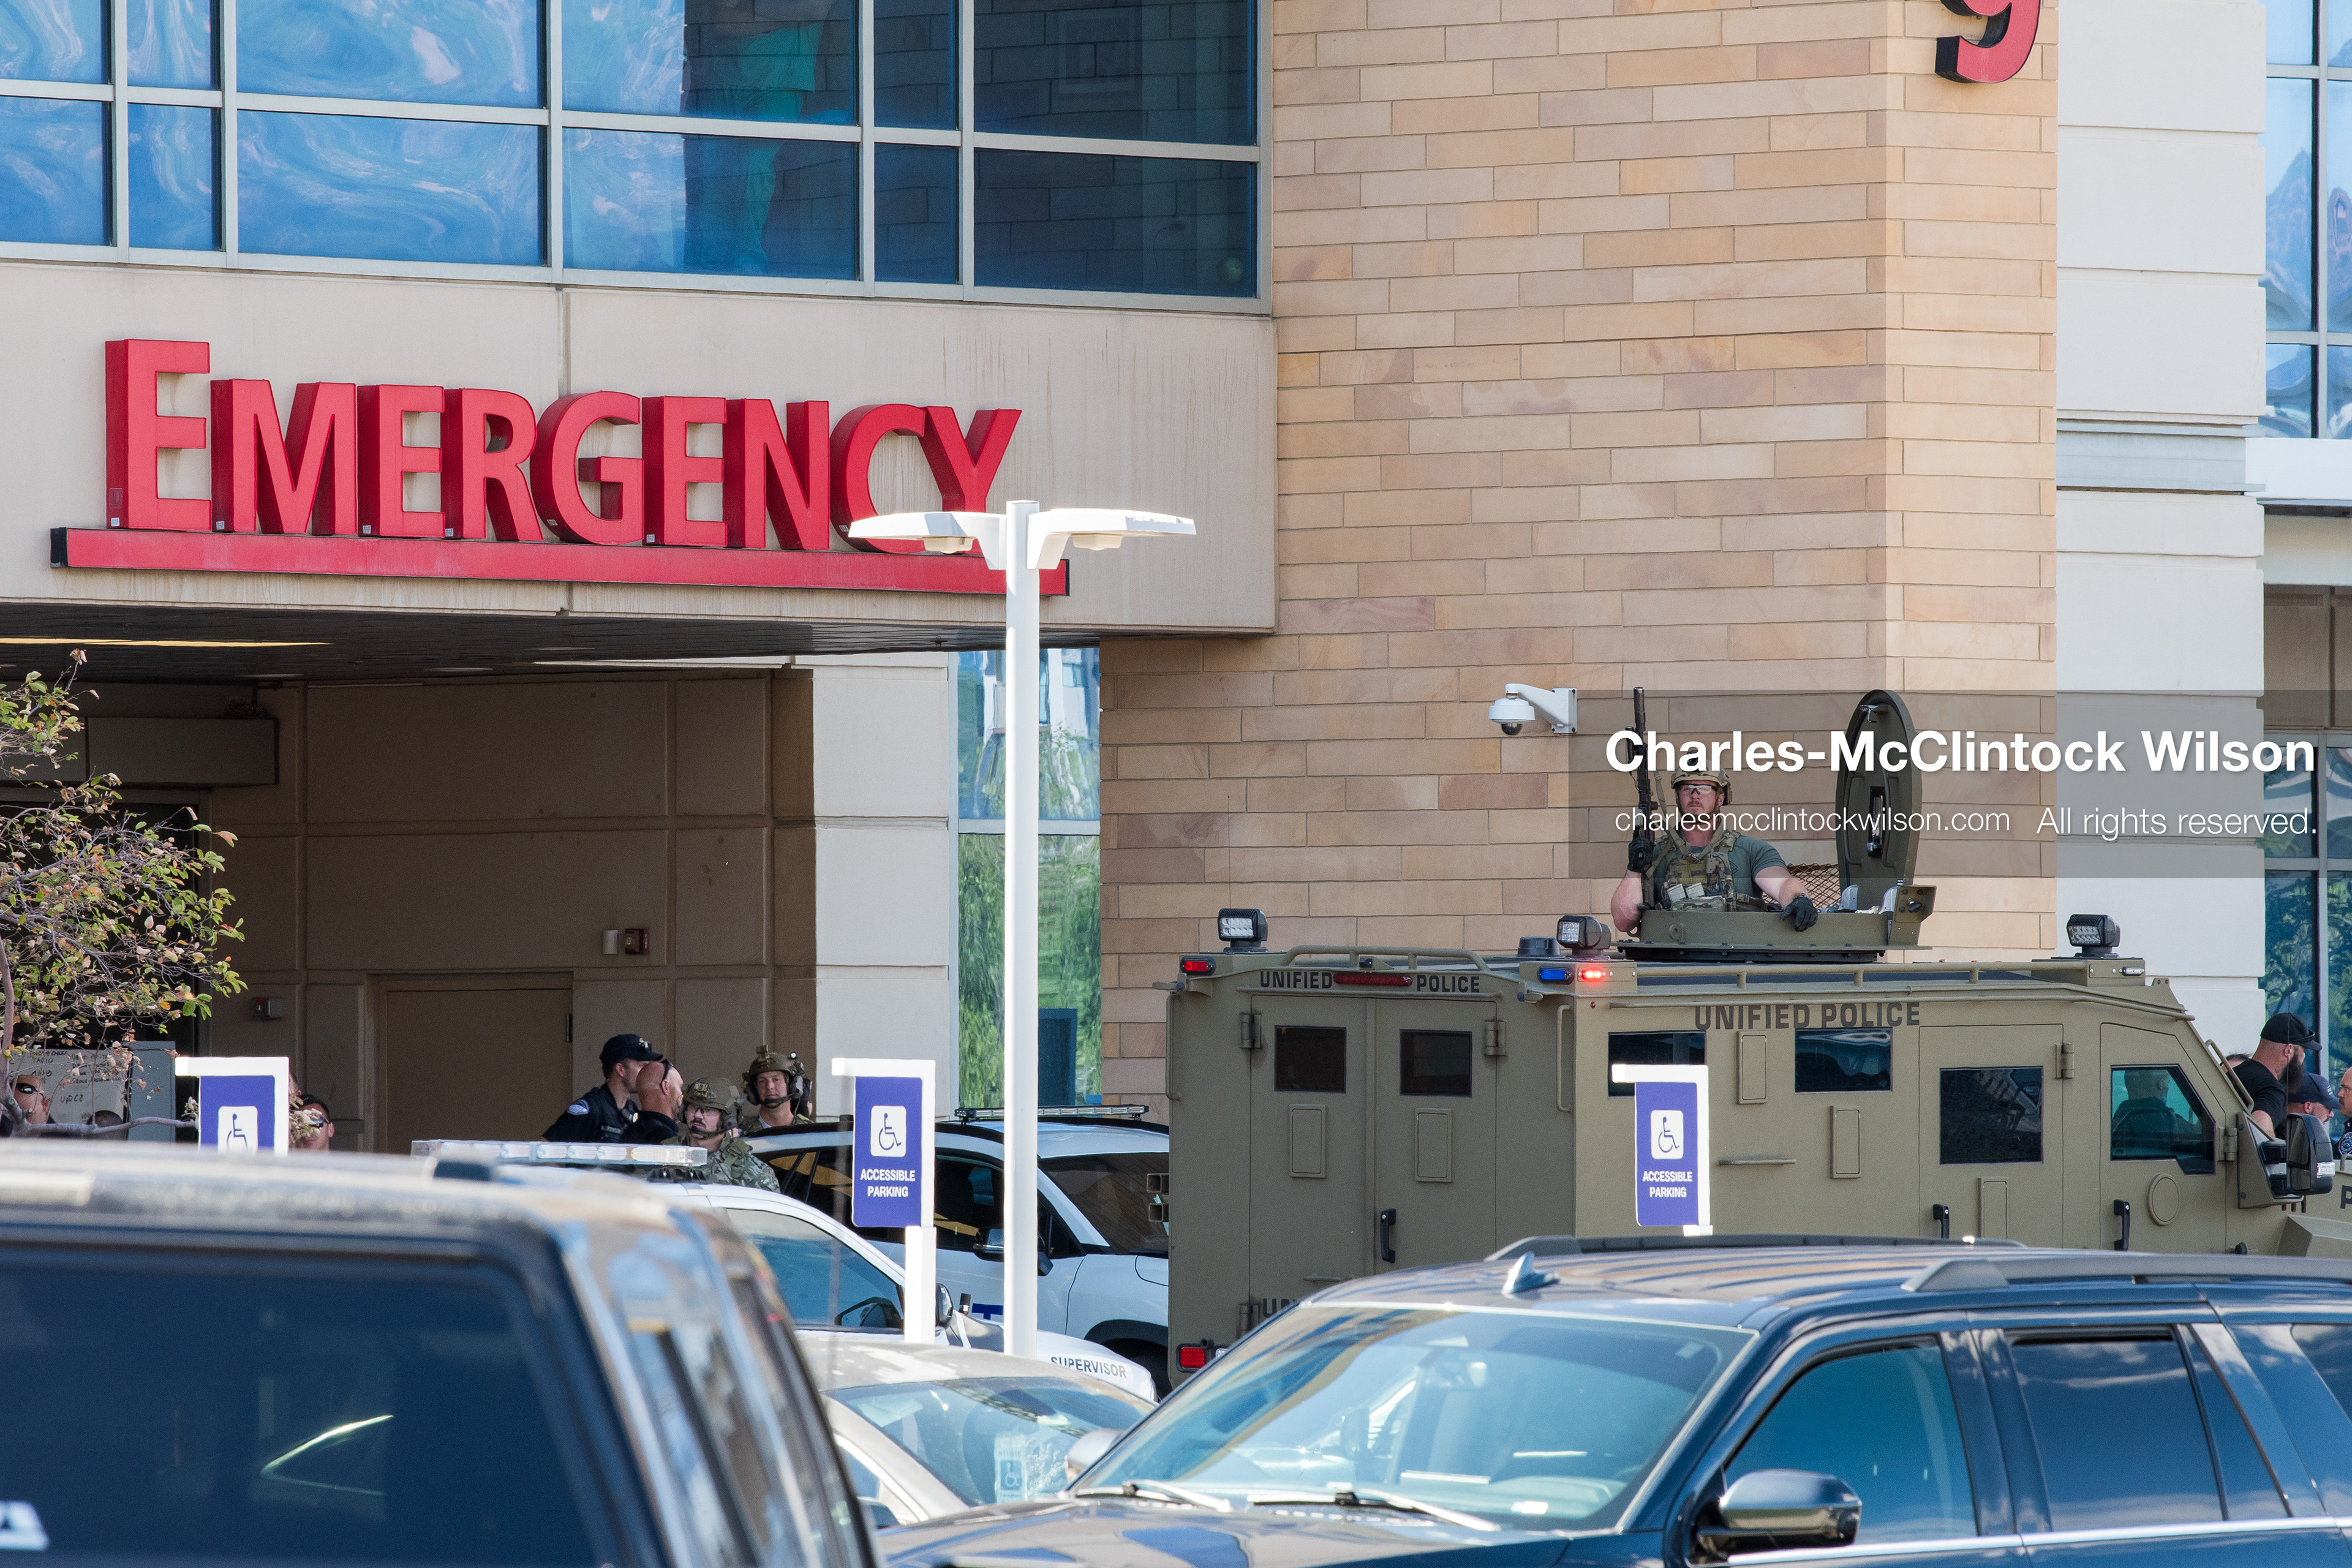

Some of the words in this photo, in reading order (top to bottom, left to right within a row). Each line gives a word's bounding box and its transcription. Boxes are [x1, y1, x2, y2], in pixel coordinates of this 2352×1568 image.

[105, 338, 1023, 555] EMERGENCY
[1259, 971, 1333, 989] UNIFIED
[1416, 975, 1480, 993] POLICE
[1694, 1004, 1810, 1030] UNIFIED
[1820, 1002, 1920, 1029] POLICE
[860, 1169, 916, 1182] ACCESSIBLE
[1642, 1170, 1693, 1182] ACCESSIBLE
[867, 1186, 909, 1197] PARKING
[1649, 1186, 1687, 1197] PARKING
[1050, 1356, 1126, 1379] SUPERVISOR
